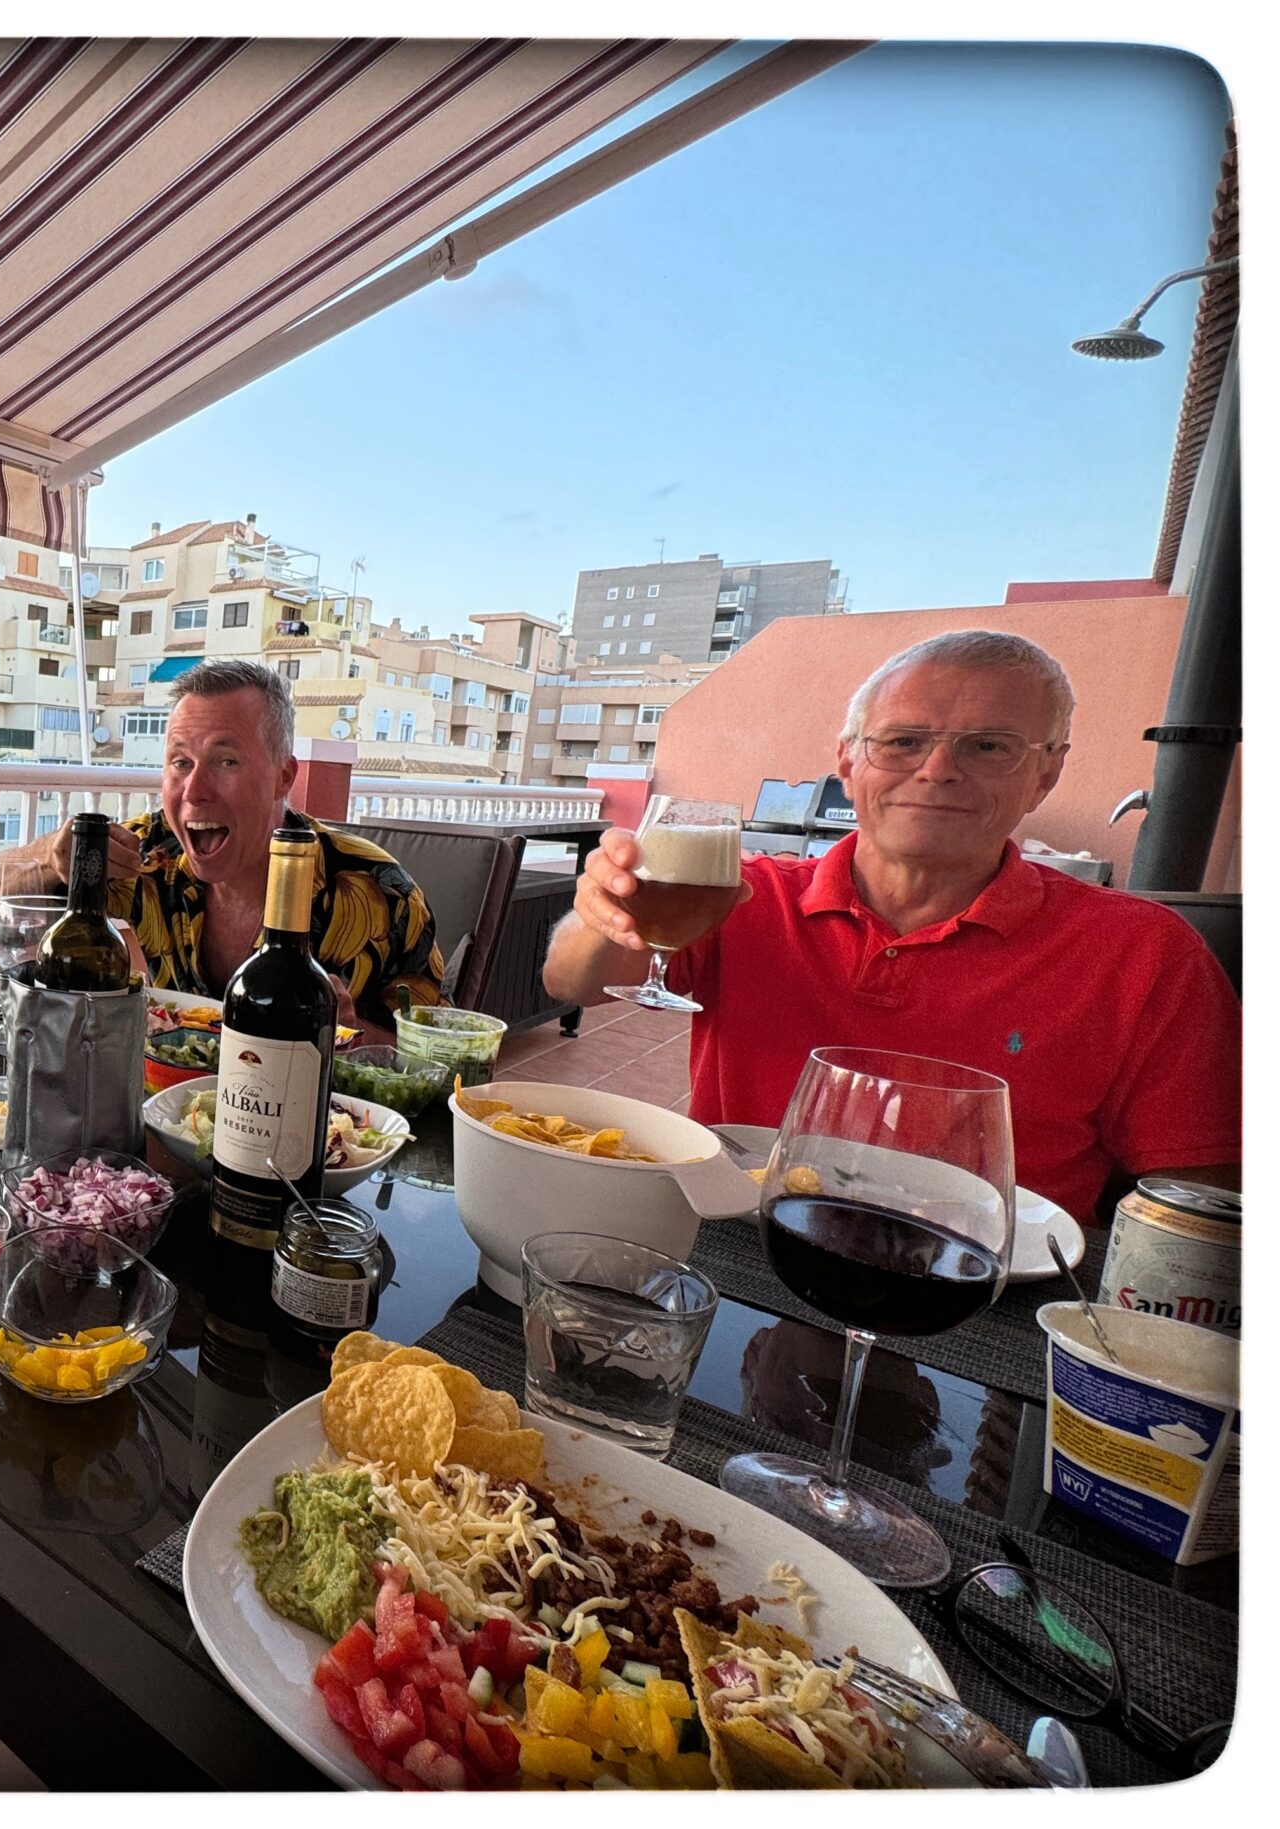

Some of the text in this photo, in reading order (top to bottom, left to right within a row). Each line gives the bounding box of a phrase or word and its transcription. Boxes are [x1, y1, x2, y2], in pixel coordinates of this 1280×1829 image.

[233, 1083, 263, 1098] Viña
[221, 1087, 283, 1118] ALBALI
[224, 1117, 271, 1138] RESERVA
